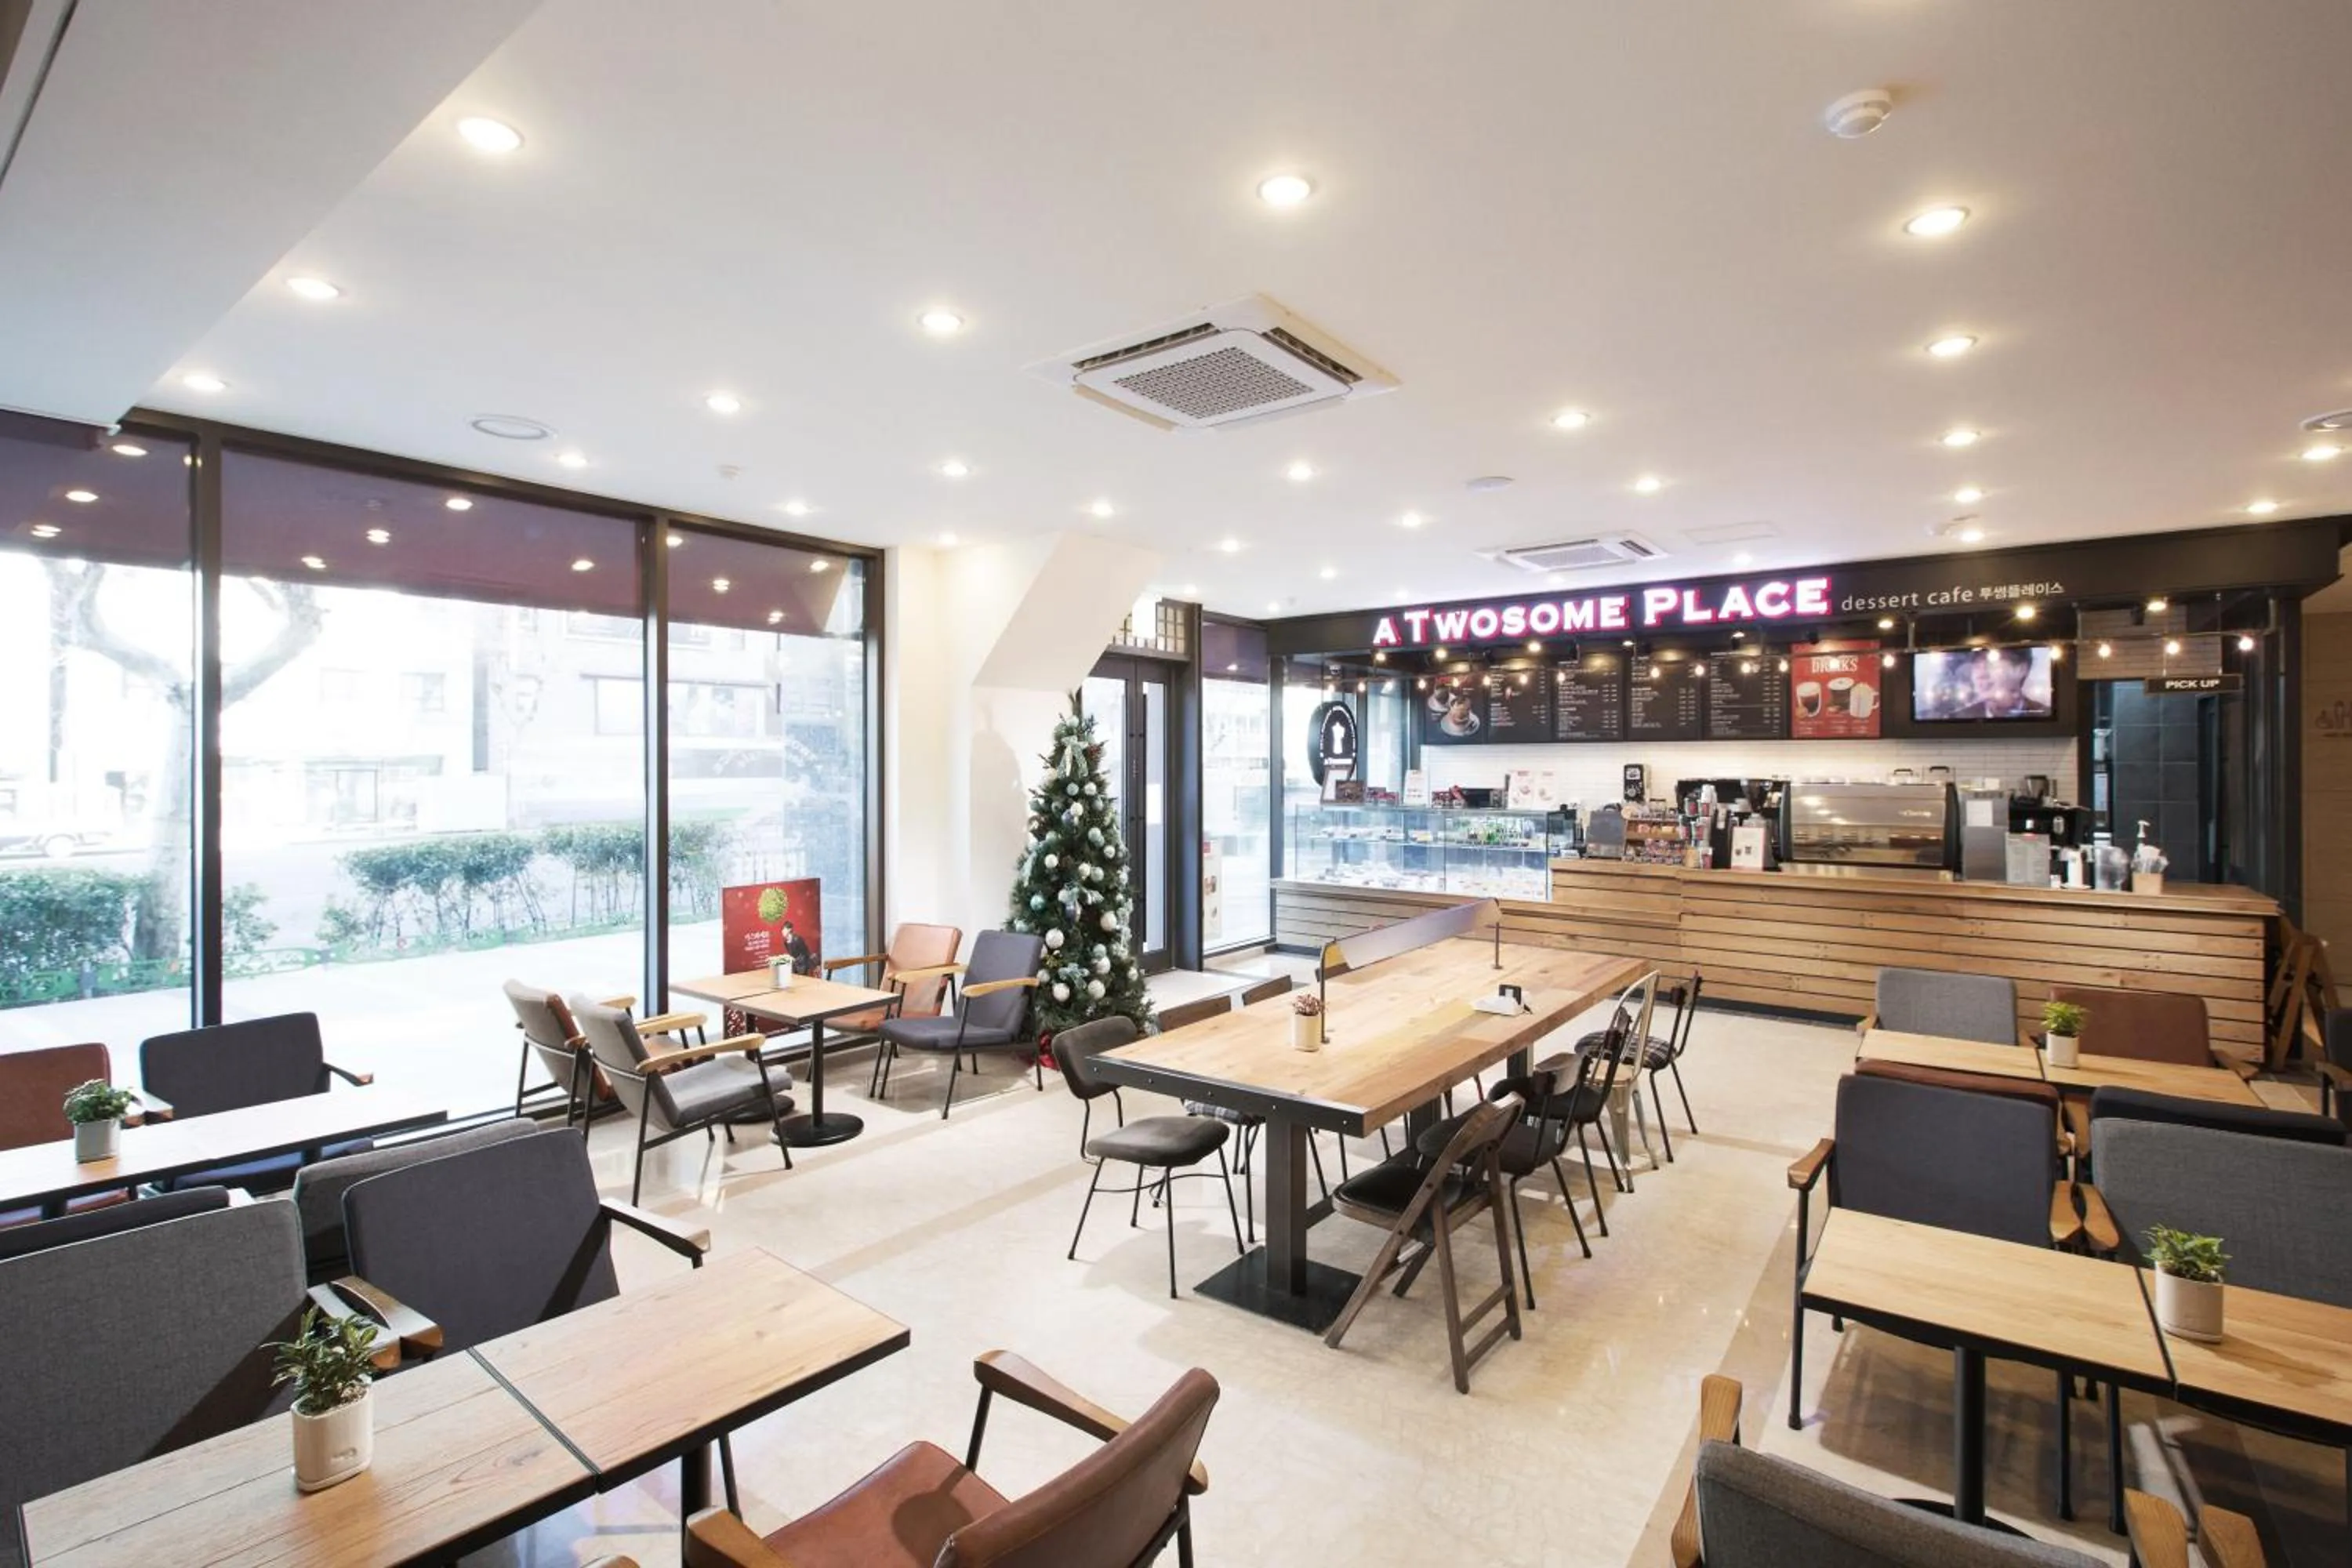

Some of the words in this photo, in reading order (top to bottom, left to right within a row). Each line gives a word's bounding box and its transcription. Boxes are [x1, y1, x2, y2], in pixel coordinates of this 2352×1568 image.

[1842, 592, 1919, 612] dessert
[1926, 586, 1974, 606] cafe
[1979, 582, 2064, 601] 투썸플레이스
[1373, 616, 1401, 646] A
[1404, 595, 1629, 644] TWOSOME
[1642, 577, 1831, 626] PLACE
[1812, 655, 1859, 673] DRKS
[2165, 680, 2198, 689] PICK
[2201, 679, 2220, 688] UP
